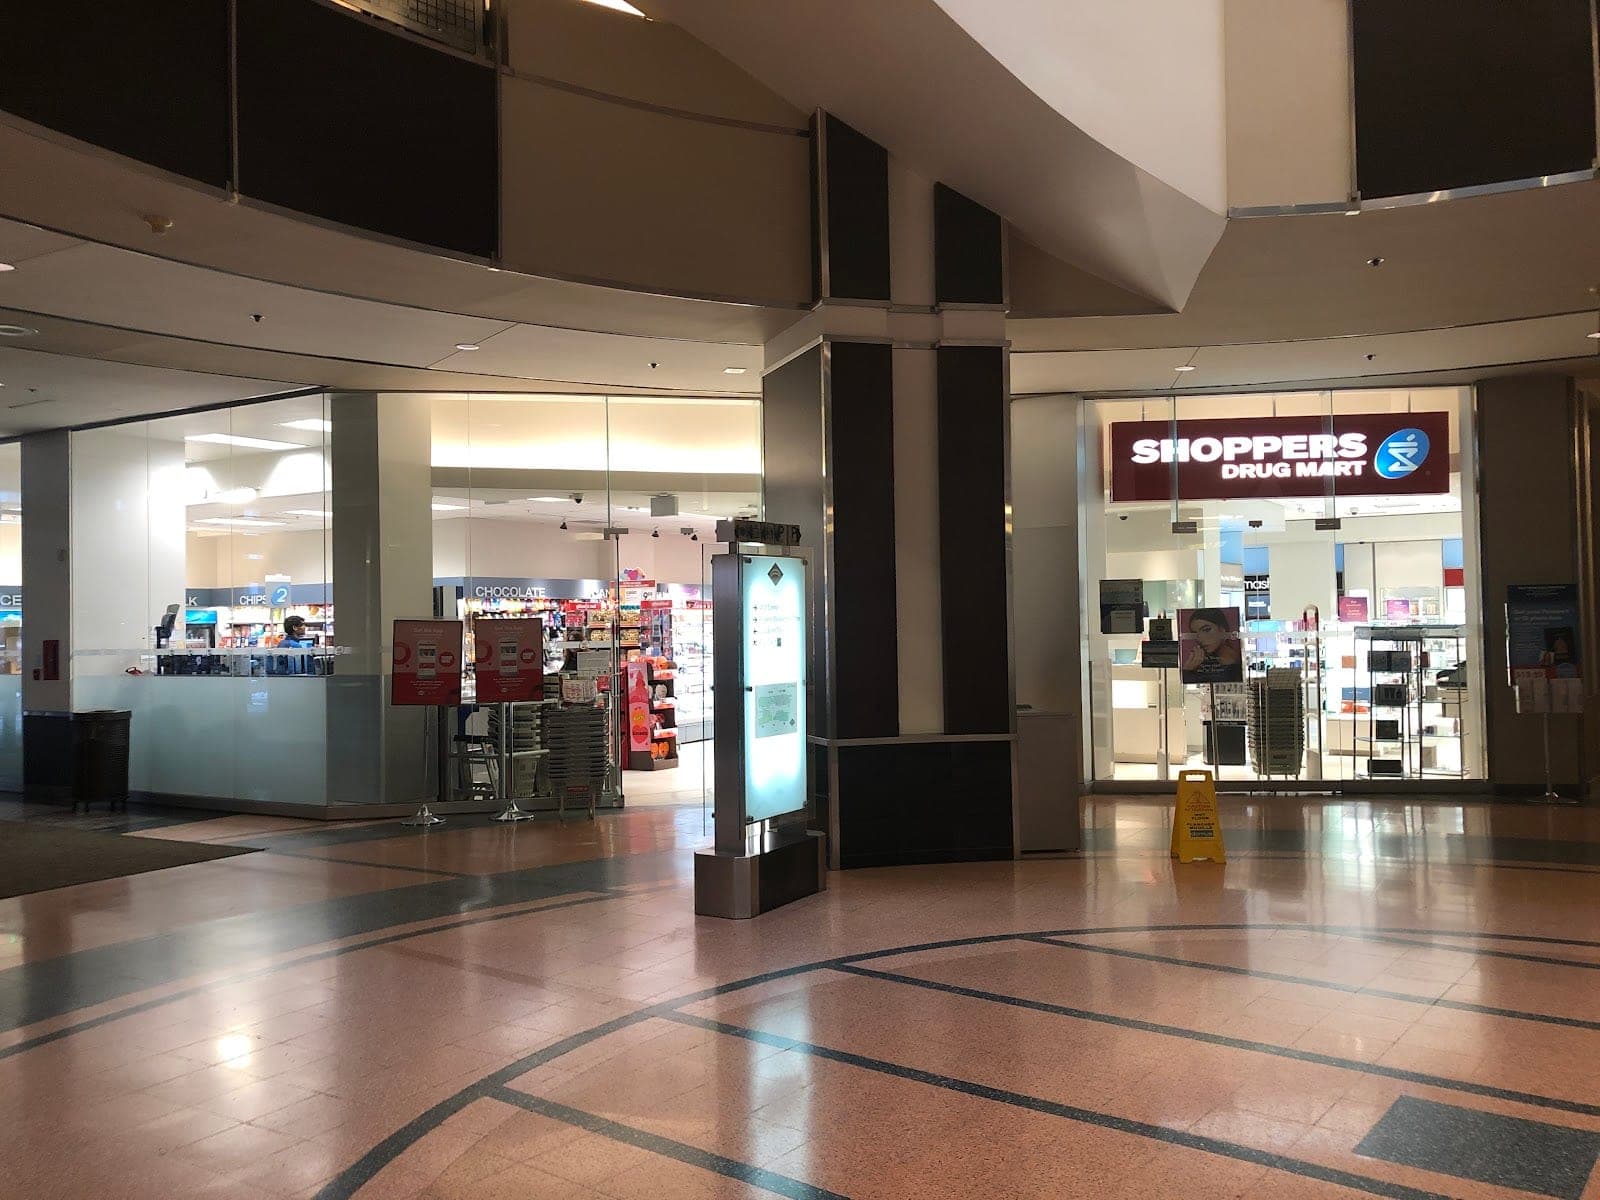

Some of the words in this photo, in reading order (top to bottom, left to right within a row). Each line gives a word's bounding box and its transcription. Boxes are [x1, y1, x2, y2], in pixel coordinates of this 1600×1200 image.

[1131, 432, 1367, 464] SHOPPERS
[1222, 462, 1291, 480] DRUG
[1295, 460, 1367, 478] MART
[276, 588, 288, 604] 2
[475, 586, 546, 598] CHOCOLATE
[239, 595, 266, 606] CHIPS
